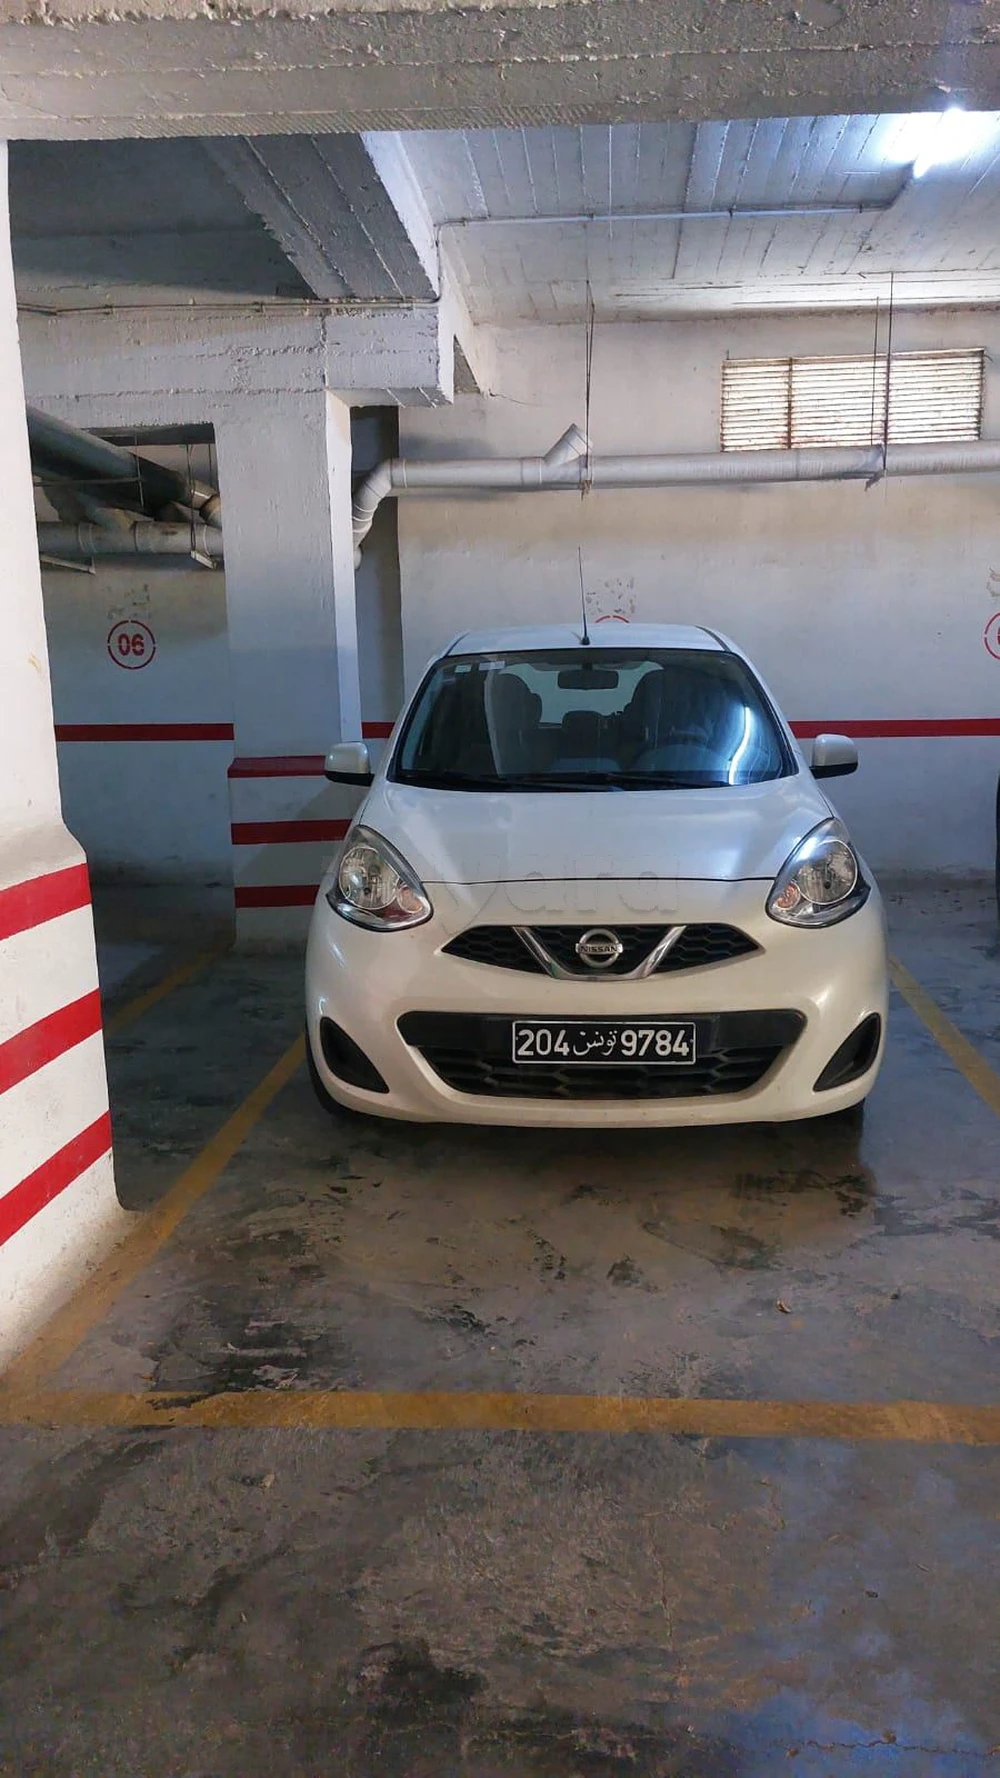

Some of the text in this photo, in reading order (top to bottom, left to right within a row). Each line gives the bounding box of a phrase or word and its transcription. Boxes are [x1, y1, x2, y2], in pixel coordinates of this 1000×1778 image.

[118, 633, 145, 656] 06
[580, 945, 618, 953] NISSAN
[517, 1029, 690, 1056] 204 تونس 9784
